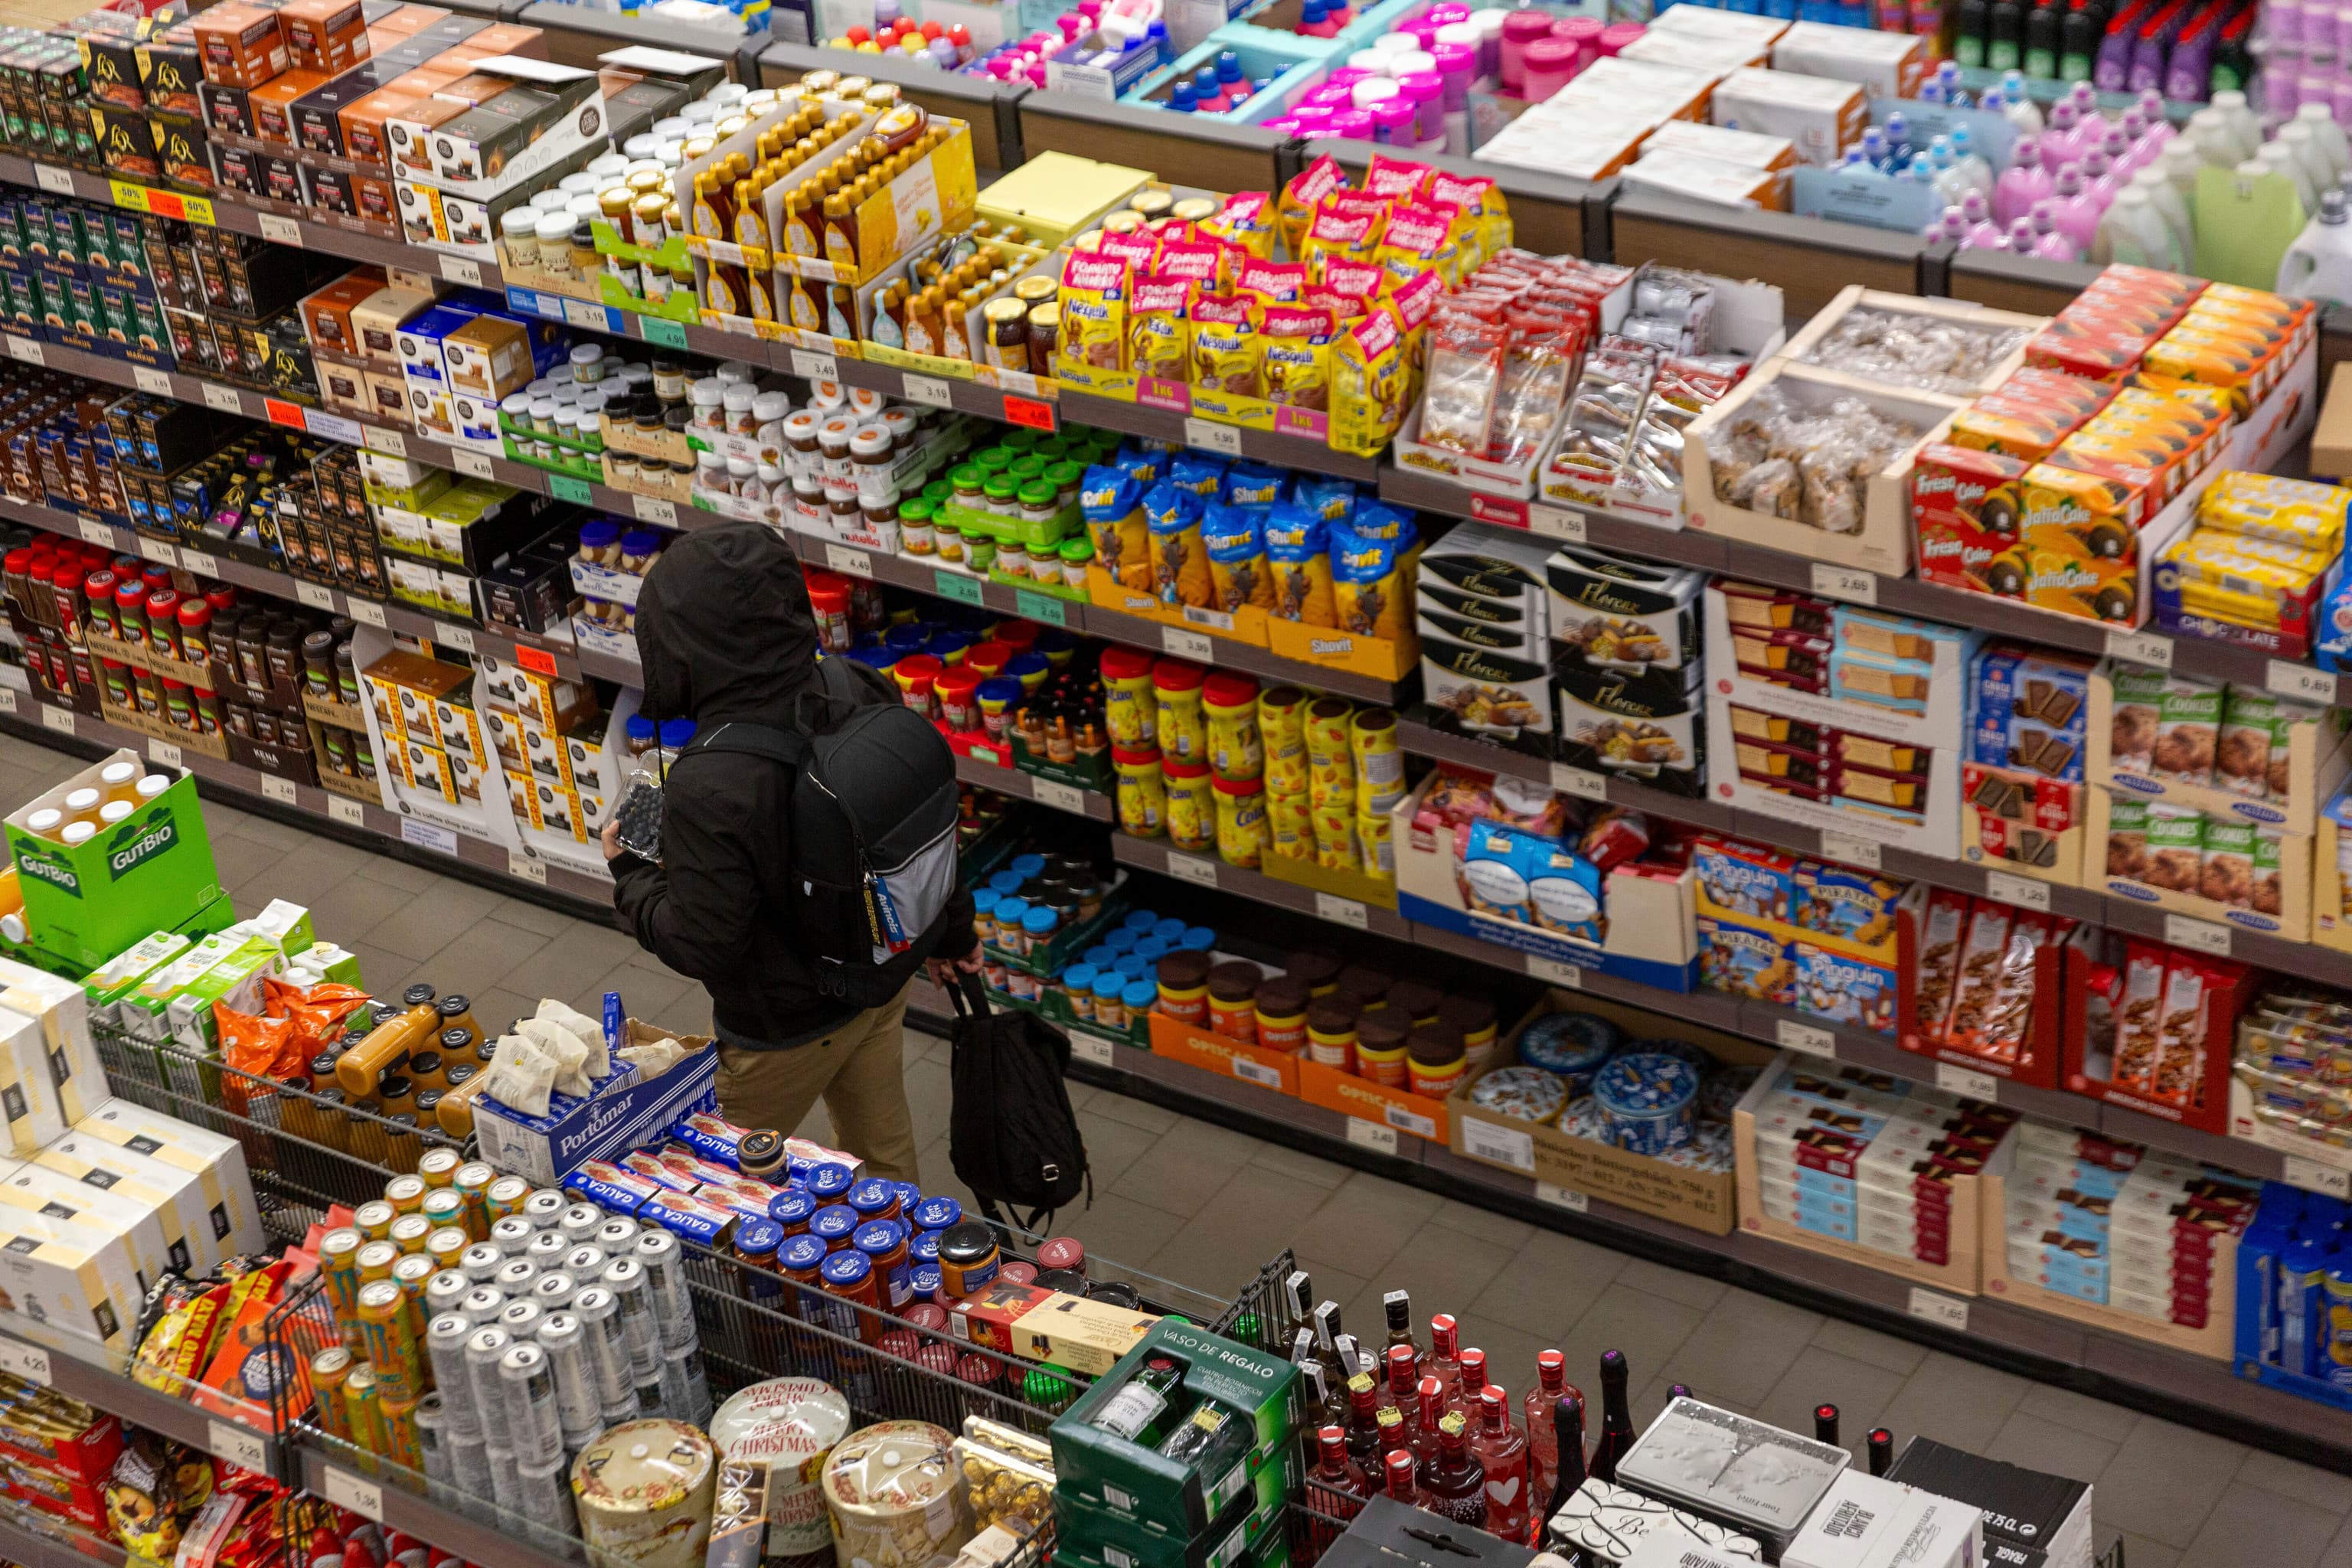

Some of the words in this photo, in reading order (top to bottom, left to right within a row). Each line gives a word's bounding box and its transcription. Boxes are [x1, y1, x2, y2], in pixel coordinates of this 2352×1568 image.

[1070, 260, 1122, 276] FORMATO
[1165, 252, 1216, 266] FORMATO
[44, 261, 75, 276] MARKUS
[106, 275, 137, 289] MARKUS
[586, 309, 604, 322] 3,19
[1068, 297, 1109, 319] Nesquik
[1, 322, 31, 337] MARKUS
[62, 335, 92, 349] MARKUS
[666, 335, 684, 345] 4,99
[1197, 332, 1243, 351] Nesquik
[126, 349, 156, 364] MARKUS
[815, 363, 835, 376] 3,49
[1060, 367, 1093, 385] Nesquik
[926, 386, 948, 399] 3,19
[1152, 381, 1159, 395] 1
[1160, 385, 1174, 397] KG
[1194, 397, 1229, 415] Nesquik
[1290, 410, 1298, 423] 1
[1298, 414, 1313, 427] KG
[808, 472, 858, 492] nutella
[1233, 485, 1276, 504] Shovit
[1955, 482, 1986, 501] Cake
[840, 532, 882, 547] nutella
[1205, 530, 1253, 550] Shovit
[849, 558, 871, 570] 4,49
[1961, 547, 1993, 565] Cake
[1124, 597, 1155, 608] Shovit
[1310, 637, 1353, 655] Shovit
[387, 685, 405, 732] GRATIS
[539, 684, 556, 730] GRATIS
[2165, 695, 2218, 714] COOKIES
[253, 748, 279, 763] KENA
[557, 737, 573, 785] GRATIS
[437, 753, 454, 799] GRATIS
[525, 779, 542, 825] GRATIS
[422, 809, 443, 823] coffee
[568, 792, 585, 840] GRATIS
[2147, 818, 2199, 836] COOKIES
[2209, 825, 2253, 843] COOKIES
[549, 854, 572, 867] coffee
[877, 893, 900, 935] Avincis
[559, 1092, 636, 1157] Portomar
[694, 1132, 737, 1157] GALICA
[588, 1179, 635, 1205] GALICA
[663, 1208, 712, 1232] GALICA
[1163, 1328, 1197, 1348] VASO
[1198, 1343, 1219, 1356] DE
[1219, 1350, 1274, 1378] REGALO
[1197, 1365, 1225, 1380] CUATRO
[1202, 1380, 1240, 1400] EQUILIBRIO
[1214, 1377, 1248, 1396] PERFECTO
[730, 1436, 818, 1455] CHRISTMAS
[1822, 1499, 1860, 1537] AFRUTADO
[1842, 1508, 1876, 1540] BLANCO
[1991, 1513, 2005, 1527] 75
[2004, 1517, 2017, 1532] CL
[1994, 1546, 2028, 1566] FRAGIL
